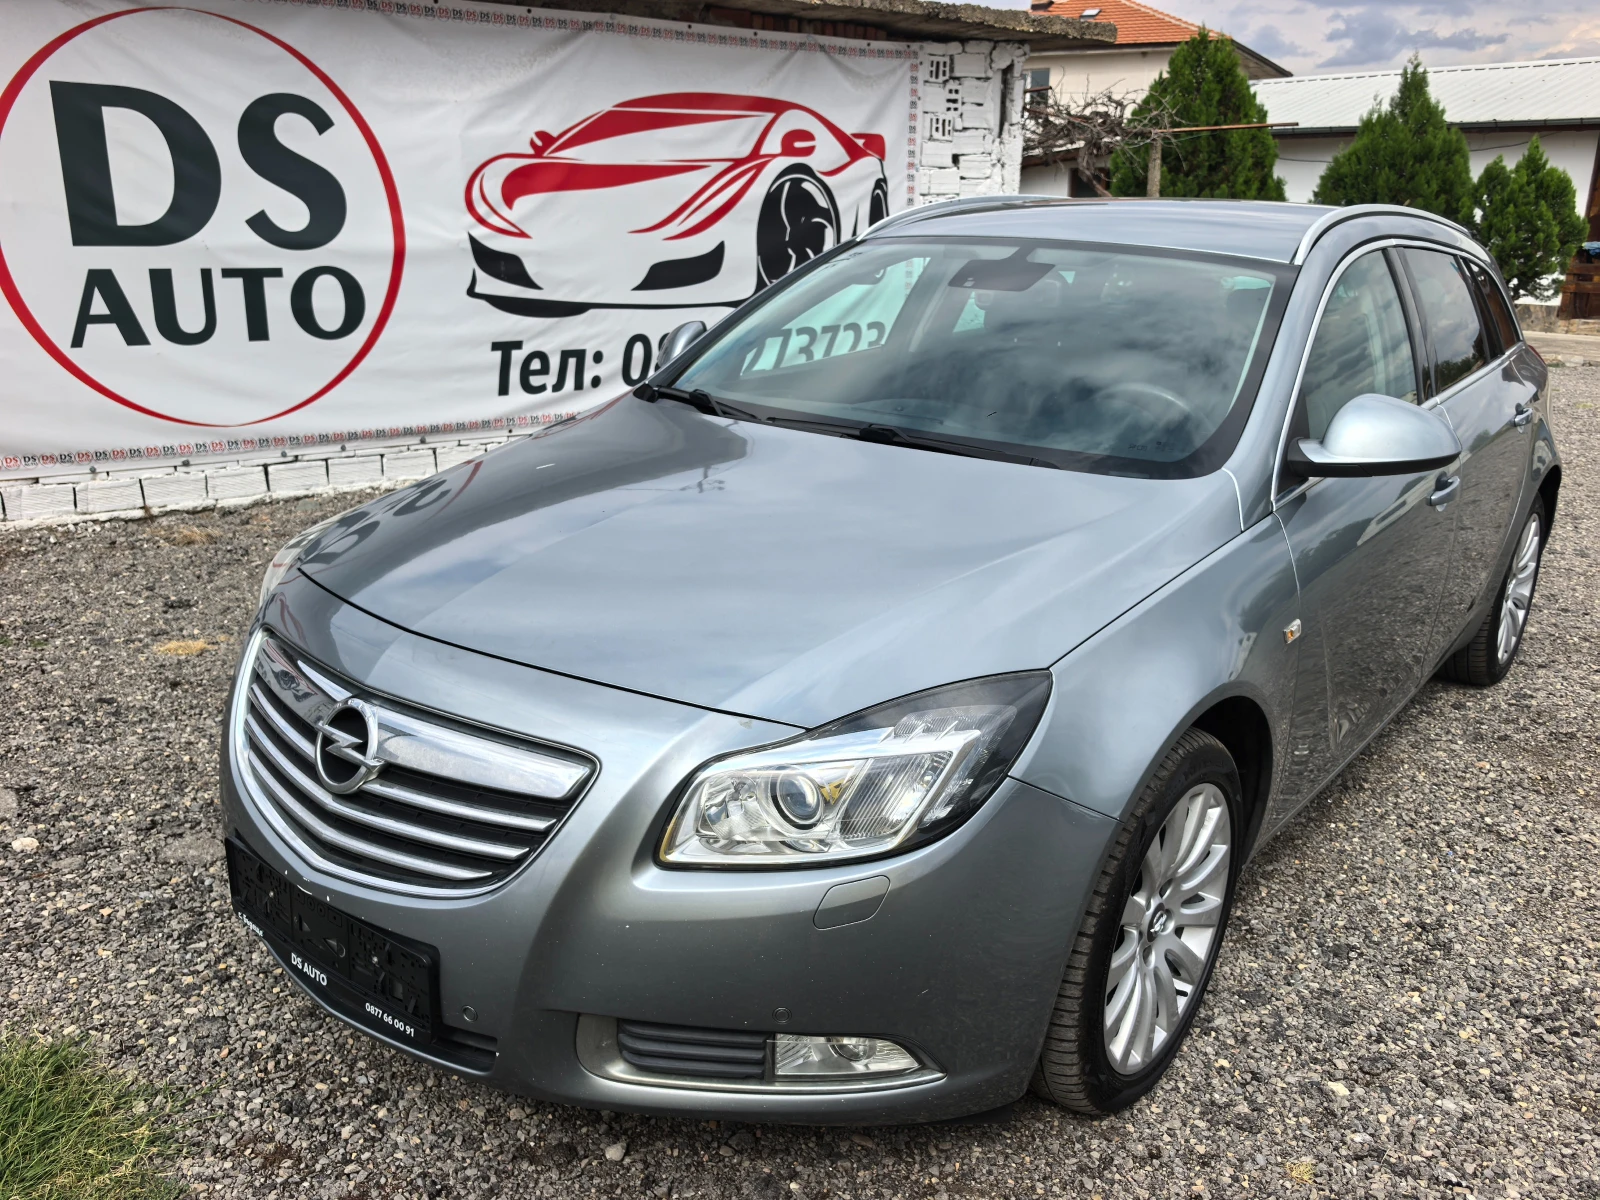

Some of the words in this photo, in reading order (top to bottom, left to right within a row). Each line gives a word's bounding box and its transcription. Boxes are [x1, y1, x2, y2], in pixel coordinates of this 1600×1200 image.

[49, 80, 347, 251] DS
[71, 266, 366, 349] AUTO
[491, 340, 604, 396] Тел:
[291, 952, 302, 969] DS
[303, 962, 327, 986] AUTO
[365, 1002, 382, 1018] 0877
[383, 1013, 393, 1025] 66
[394, 1018, 405, 1031] 00
[405, 1025, 414, 1037] 91
